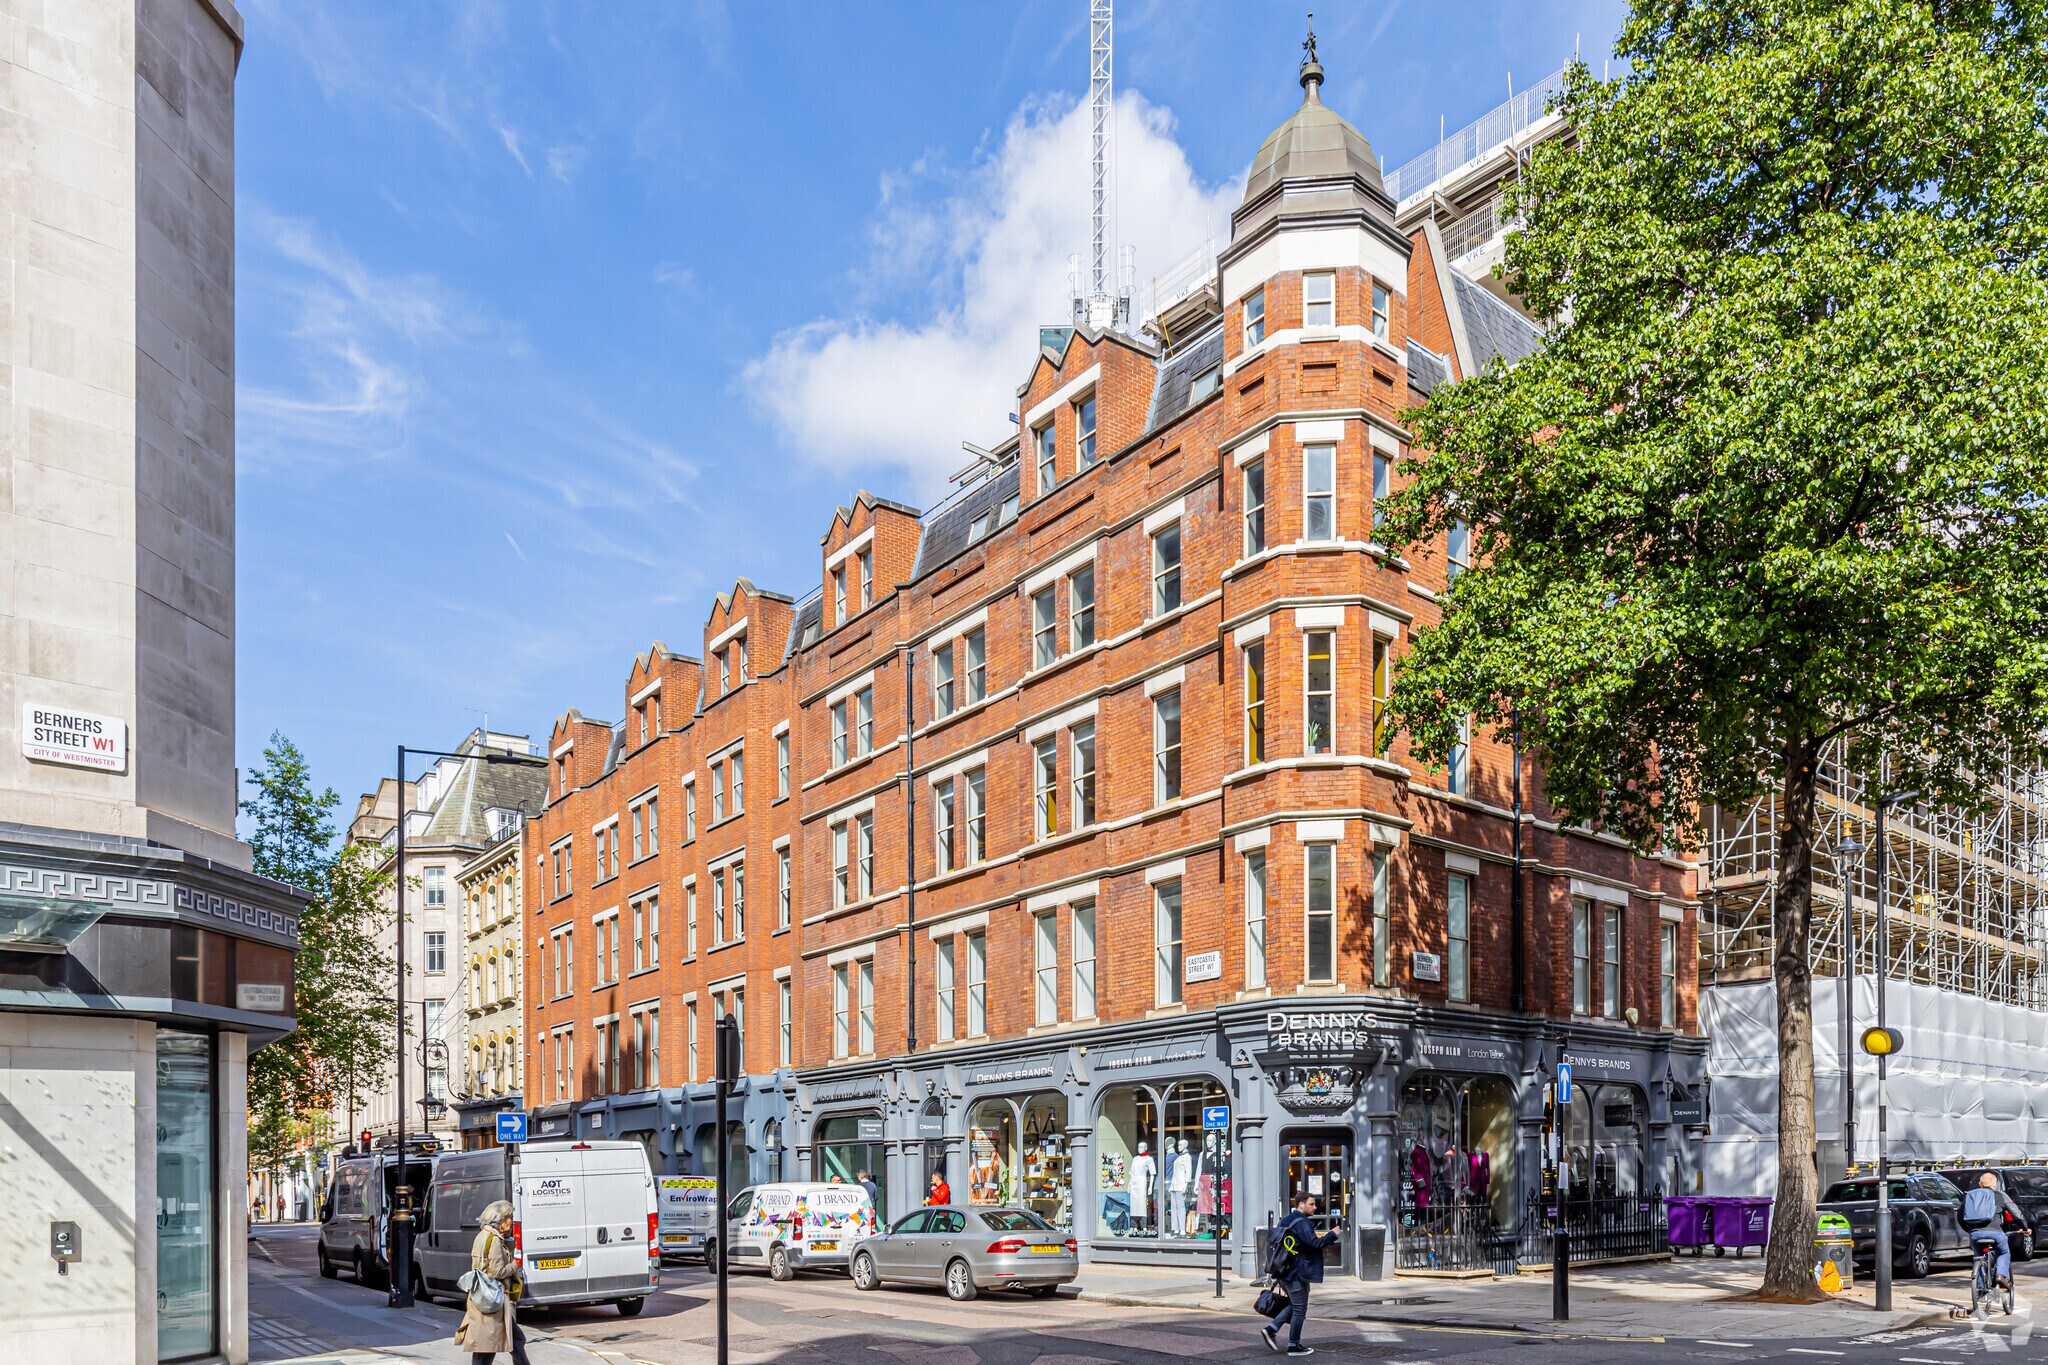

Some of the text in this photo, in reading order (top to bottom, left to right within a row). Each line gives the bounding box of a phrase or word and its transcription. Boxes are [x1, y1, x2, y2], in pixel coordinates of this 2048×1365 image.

[1470, 152, 1489, 168] VKE
[1409, 188, 1428, 204] VKE
[1466, 246, 1486, 262] VKE
[34, 710, 102, 734] BERNERS
[34, 727, 114, 752] STREET W1
[34, 748, 50, 757] CITY
[64, 753, 116, 767] WESTMINSTER
[1188, 954, 1216, 966] EASTCASTLE
[1417, 954, 1434, 964] BERNERS
[1188, 964, 1205, 974] STREET
[1417, 962, 1431, 971] STREET
[1267, 1013, 1378, 1031] DENNYS
[1278, 1031, 1368, 1045] BRANDS
[1160, 1049, 1206, 1062] London Tailors
[1420, 1045, 1460, 1056] JOSEPH ALAN
[1468, 1048, 1504, 1059] London Tailors
[1109, 1055, 1152, 1069] JOSEPH ALAN
[1563, 1054, 1631, 1070] DENNYS BRANDS
[977, 1066, 1054, 1084] DENNYS BRANDS
[541, 1180, 562, 1188] AOT
[532, 1188, 571, 1196] LOGISTICS
[768, 1194, 790, 1205] BRAND
[817, 1194, 858, 1205] J BRAND
[558, 1259, 572, 1267] KUE
